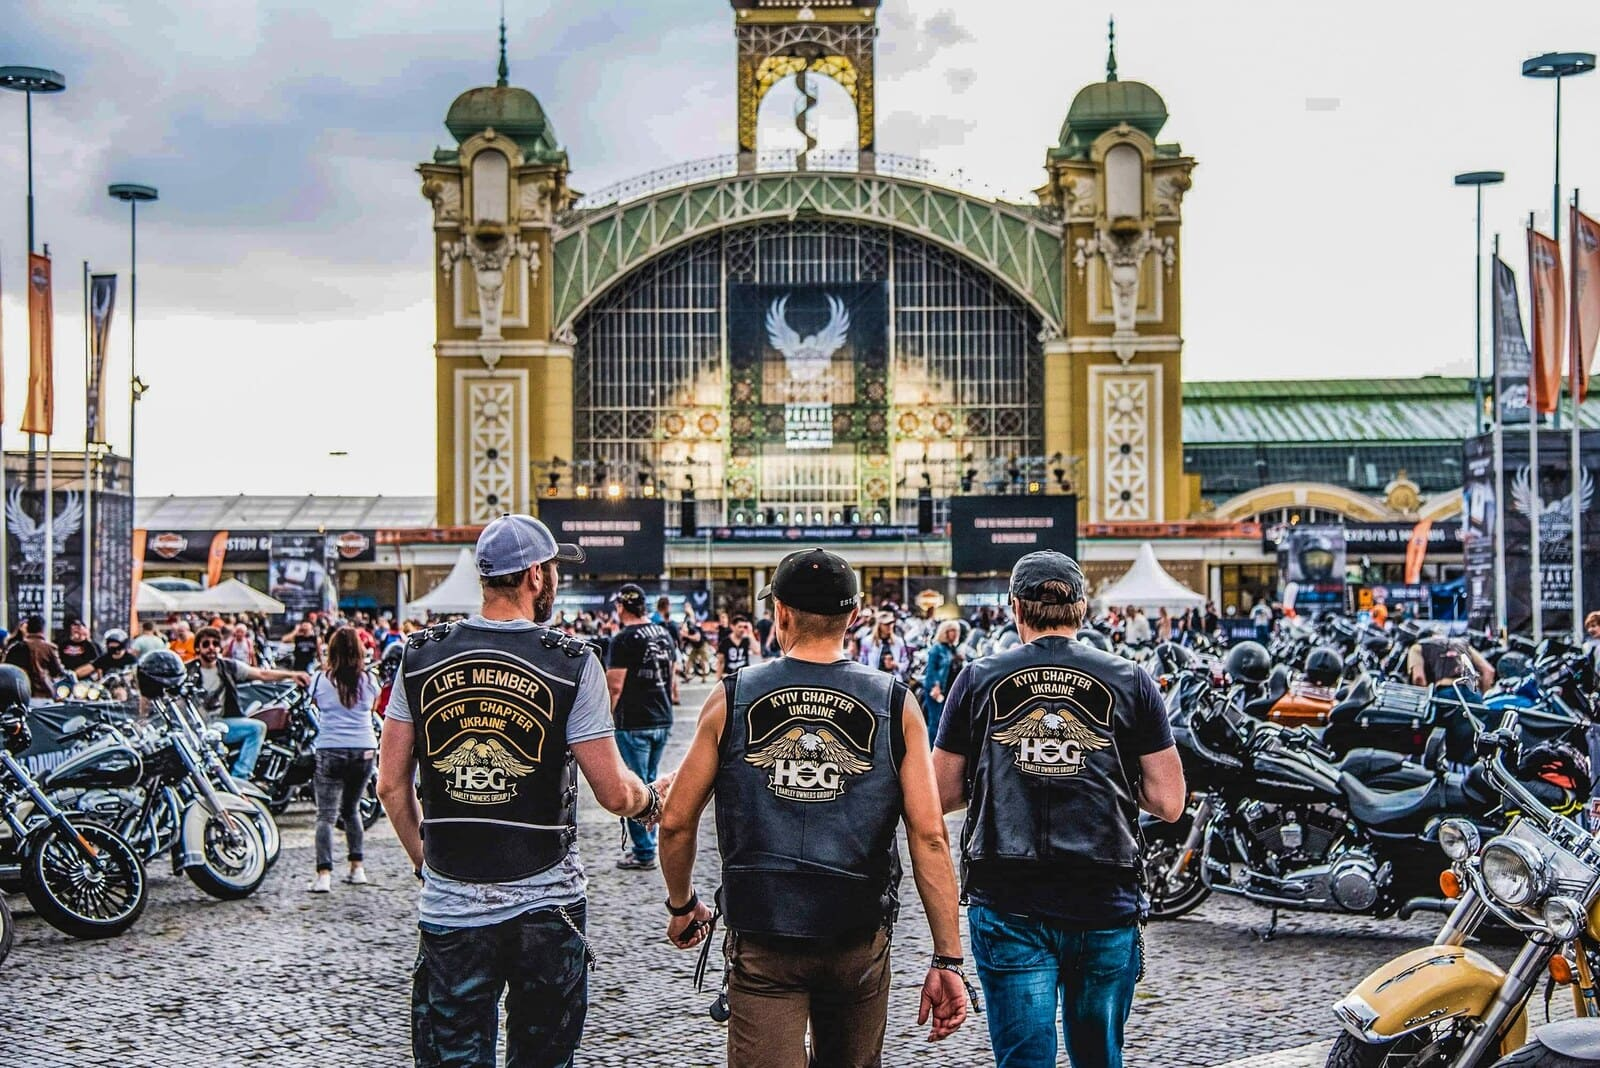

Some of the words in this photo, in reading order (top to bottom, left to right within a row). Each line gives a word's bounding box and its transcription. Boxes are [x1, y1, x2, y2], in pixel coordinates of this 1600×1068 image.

[434, 671, 466, 693] LIFE
[472, 668, 540, 699] MEMBER
[1013, 671, 1039, 688] KYIV
[1042, 670, 1092, 691] CHAPTER
[1031, 683, 1075, 697] UKRAINE
[770, 692, 798, 708] KYIV
[802, 691, 855, 714] CHAPTER
[788, 704, 836, 719] UKRAINE
[440, 704, 465, 722] KYIV
[479, 701, 534, 733] CHAPTER
[460, 716, 507, 731] UKRAINE
[1020, 737, 1082, 765] HOG
[454, 766, 507, 790] HOG
[773, 758, 840, 789] HOG
